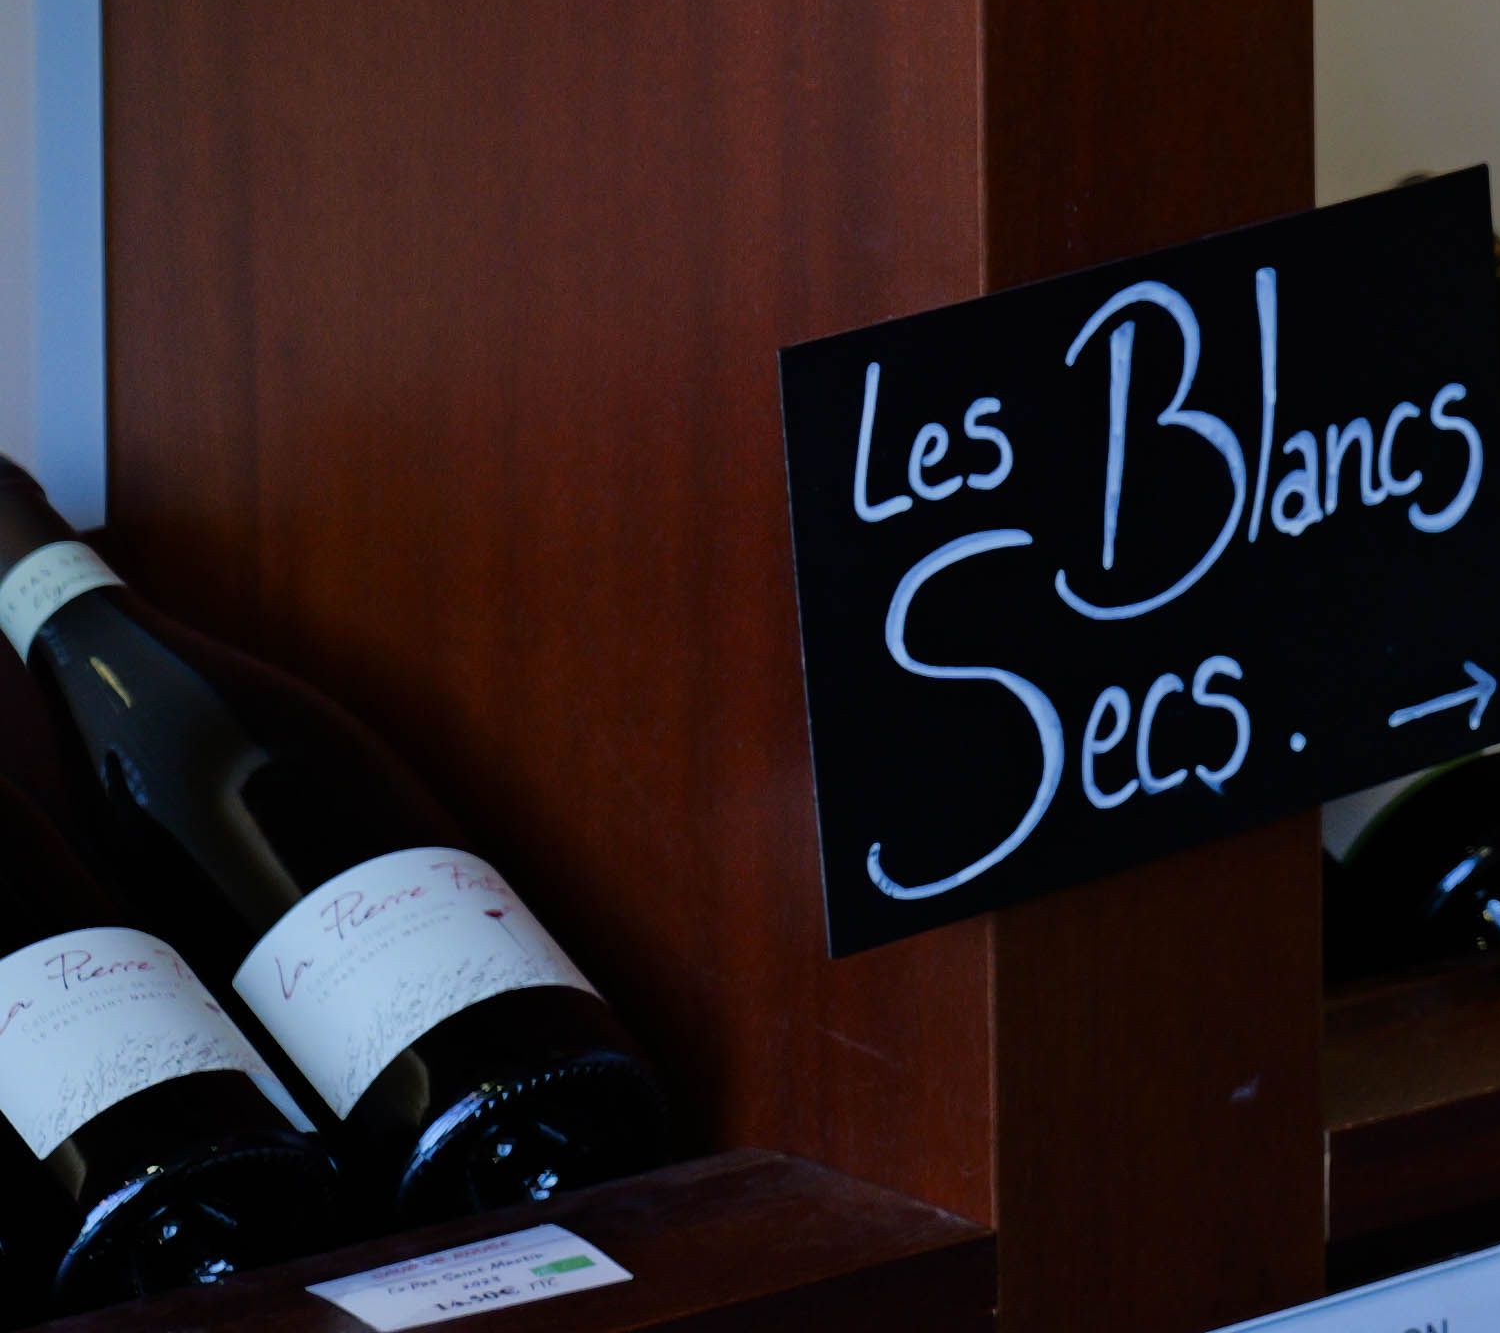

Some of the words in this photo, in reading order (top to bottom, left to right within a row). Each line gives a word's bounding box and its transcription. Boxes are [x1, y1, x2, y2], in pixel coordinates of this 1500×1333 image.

[853, 361, 1014, 523] Les
[1054, 267, 1485, 621] Blancs
[866, 528, 1307, 900] Secs.
[44, 948, 155, 991] Pierre
